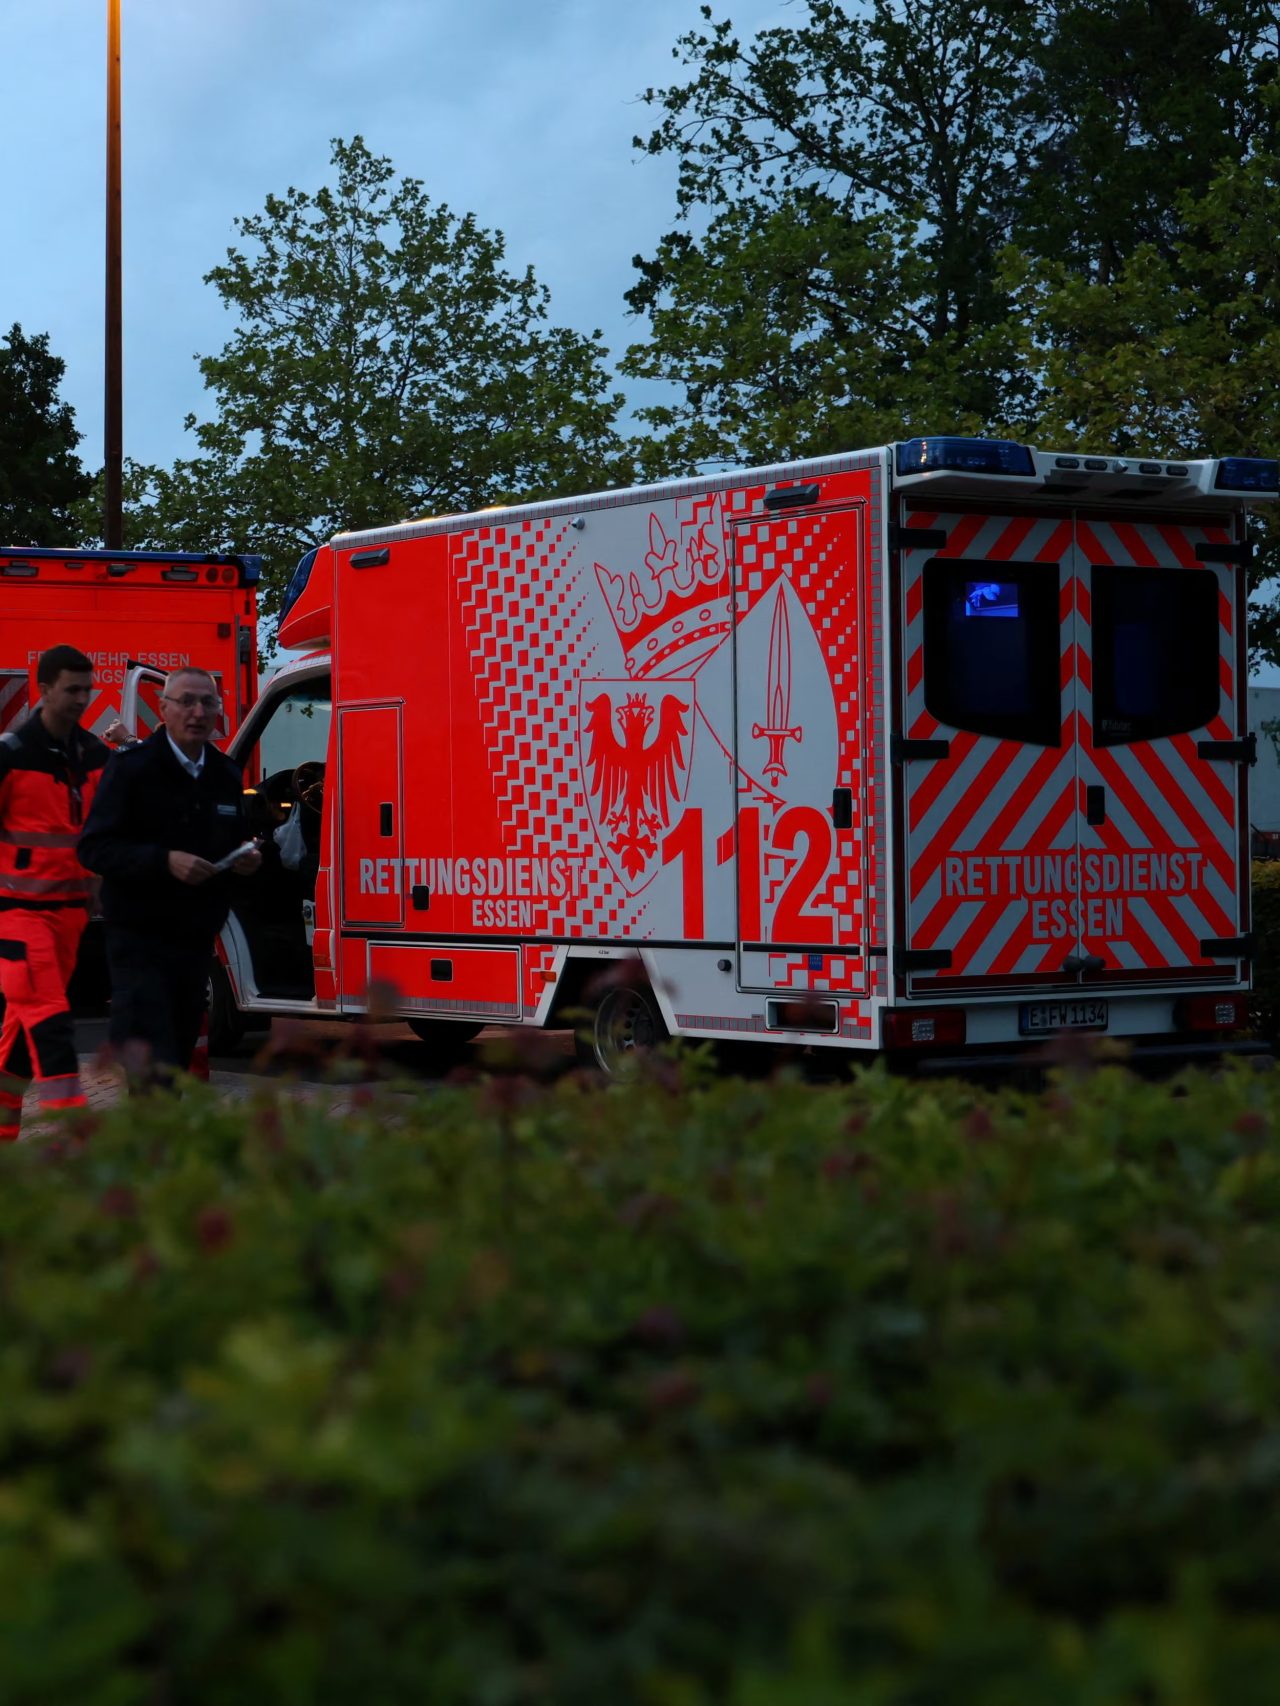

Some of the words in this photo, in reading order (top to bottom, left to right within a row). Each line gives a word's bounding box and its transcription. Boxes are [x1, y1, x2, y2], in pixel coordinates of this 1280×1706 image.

[137, 652, 190, 667] ESSEN
[360, 857, 584, 897] RETTUNGSDIENST
[661, 806, 833, 944] 112
[945, 853, 1202, 896] RETTUNGSDIENST
[472, 900, 531, 928] ESSEN
[1032, 898, 1123, 938] ESSEN
[1030, 1007, 1039, 1027] E
[1071, 1004, 1104, 1024] 1134
